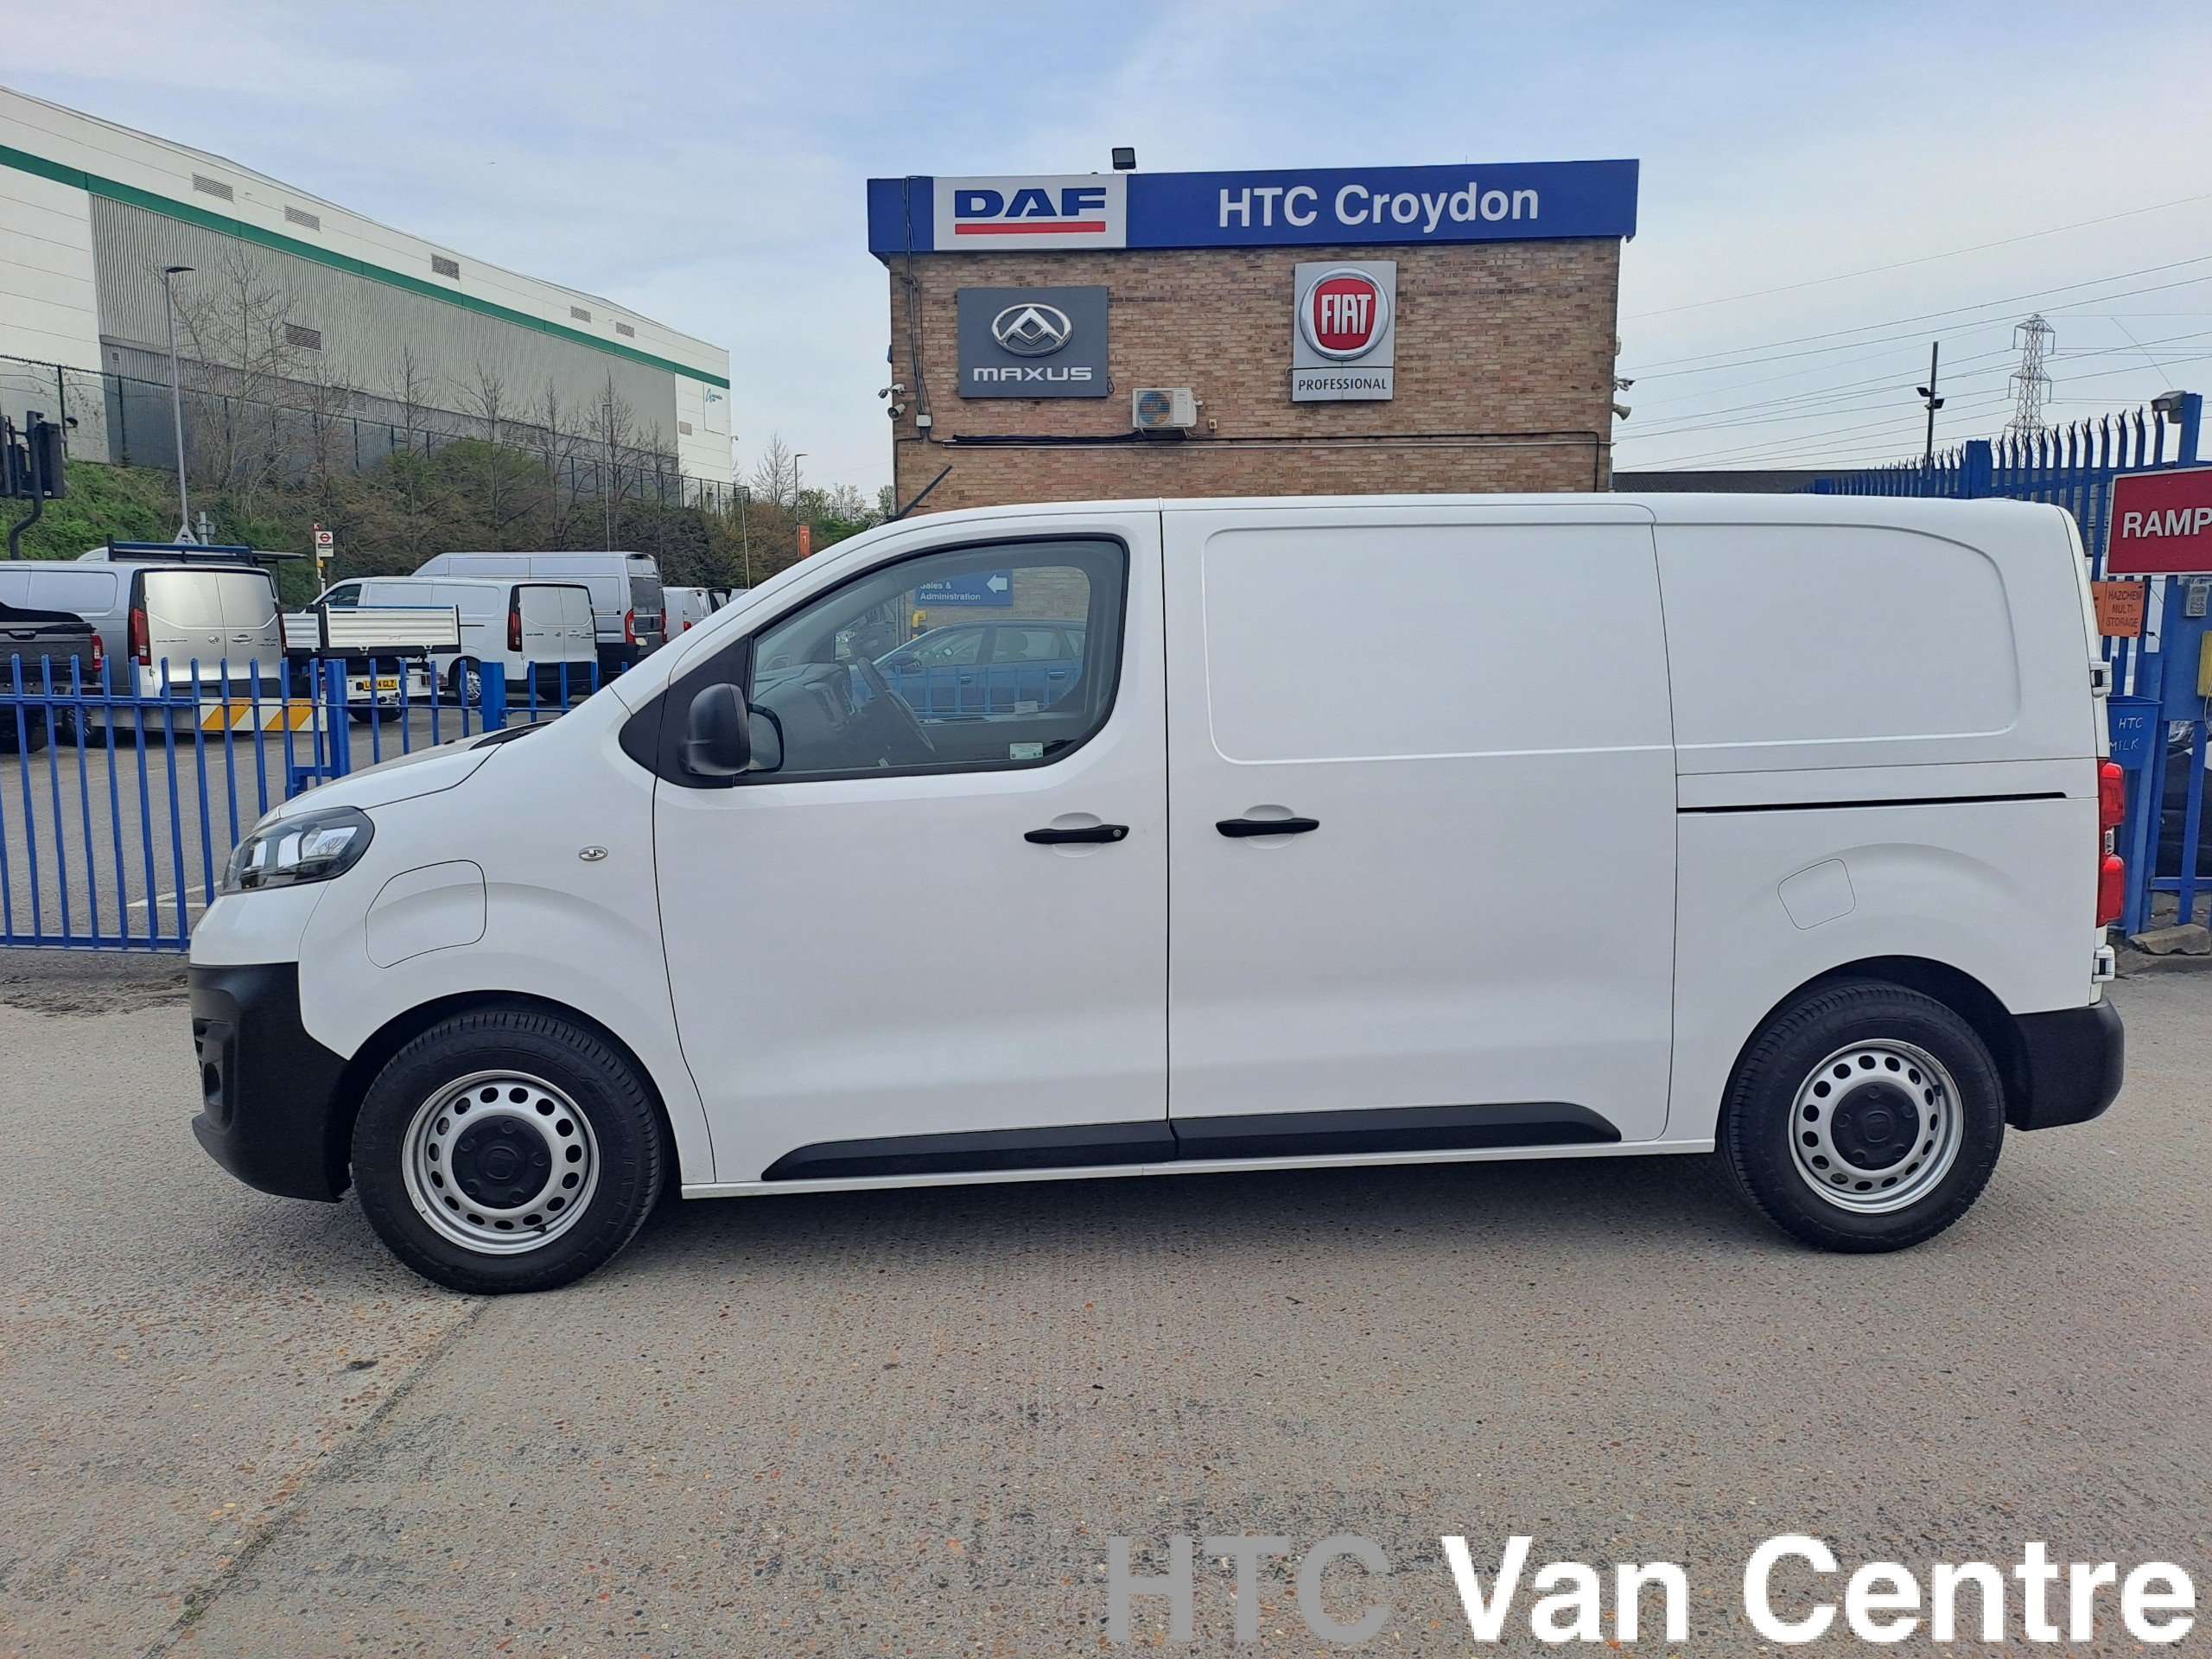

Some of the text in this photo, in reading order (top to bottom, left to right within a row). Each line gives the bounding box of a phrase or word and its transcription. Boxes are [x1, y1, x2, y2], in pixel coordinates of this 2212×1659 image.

[954, 187, 1107, 218] DAF
[1218, 181, 1539, 234] HTC Croydon
[1320, 294, 1372, 335] FIAT
[973, 366, 1092, 382] MAXUS
[1298, 378, 1387, 391] PROFESSIONAL
[2122, 507, 2212, 539] RAMP
[919, 592, 981, 601] Administration
[2108, 589, 2142, 601] HAZCHEM
[2107, 616, 2139, 628] STORAGE
[2119, 717, 2143, 729] HTC
